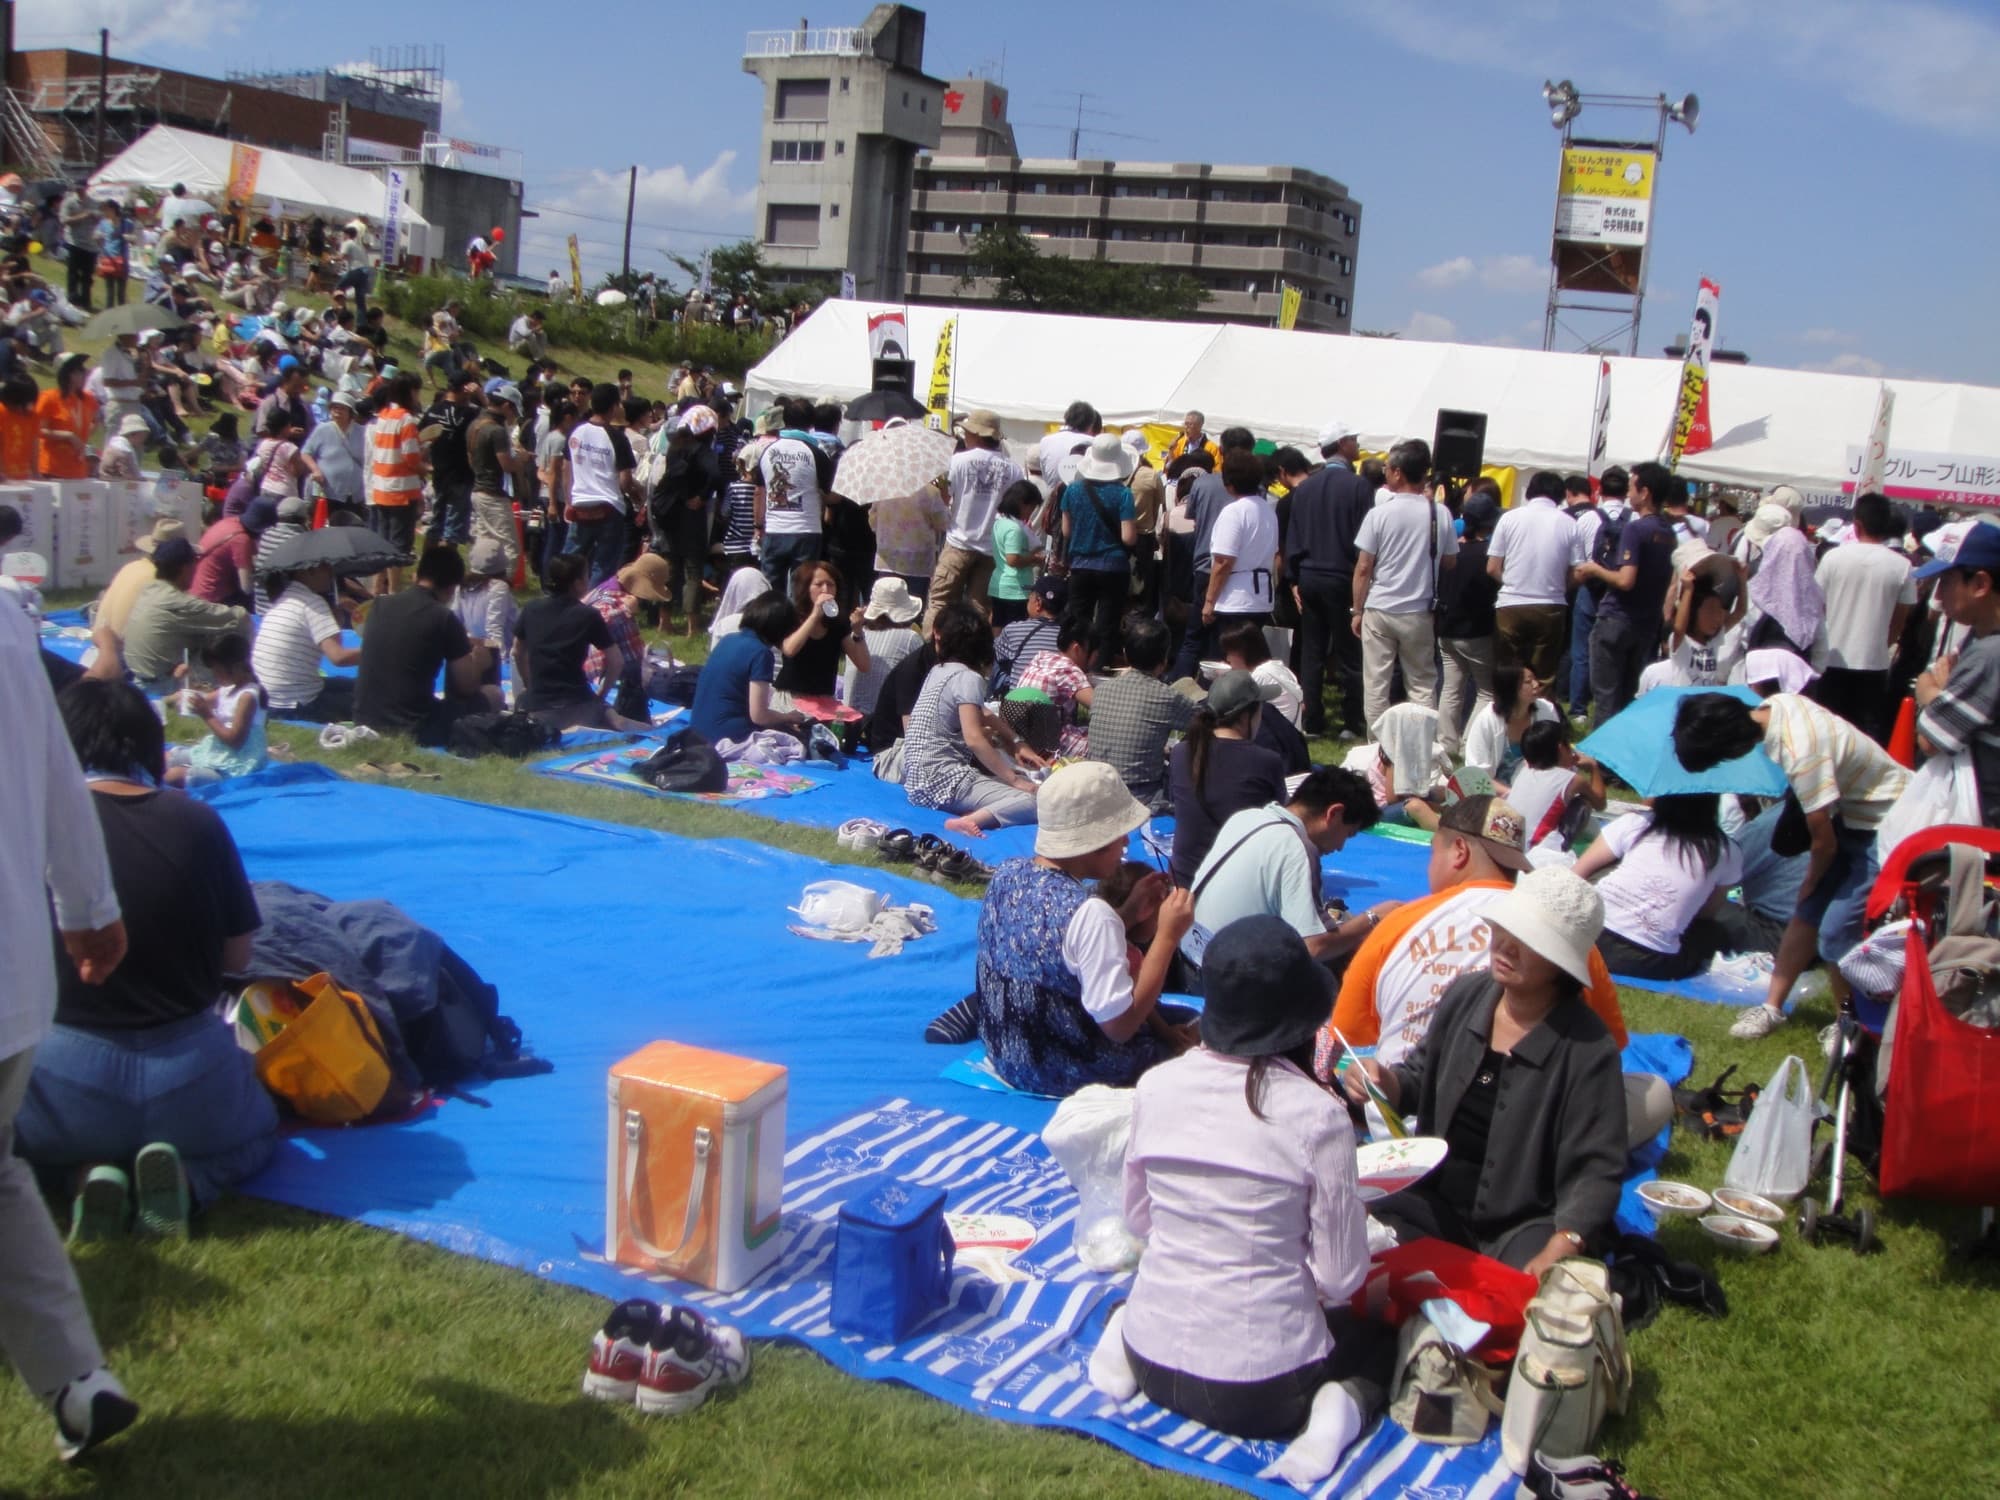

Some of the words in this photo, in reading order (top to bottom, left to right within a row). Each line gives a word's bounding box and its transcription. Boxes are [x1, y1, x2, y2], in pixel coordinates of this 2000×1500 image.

[1604, 206, 1636, 218] 株式会社
[1849, 455, 2000, 487] Jグループ山形
